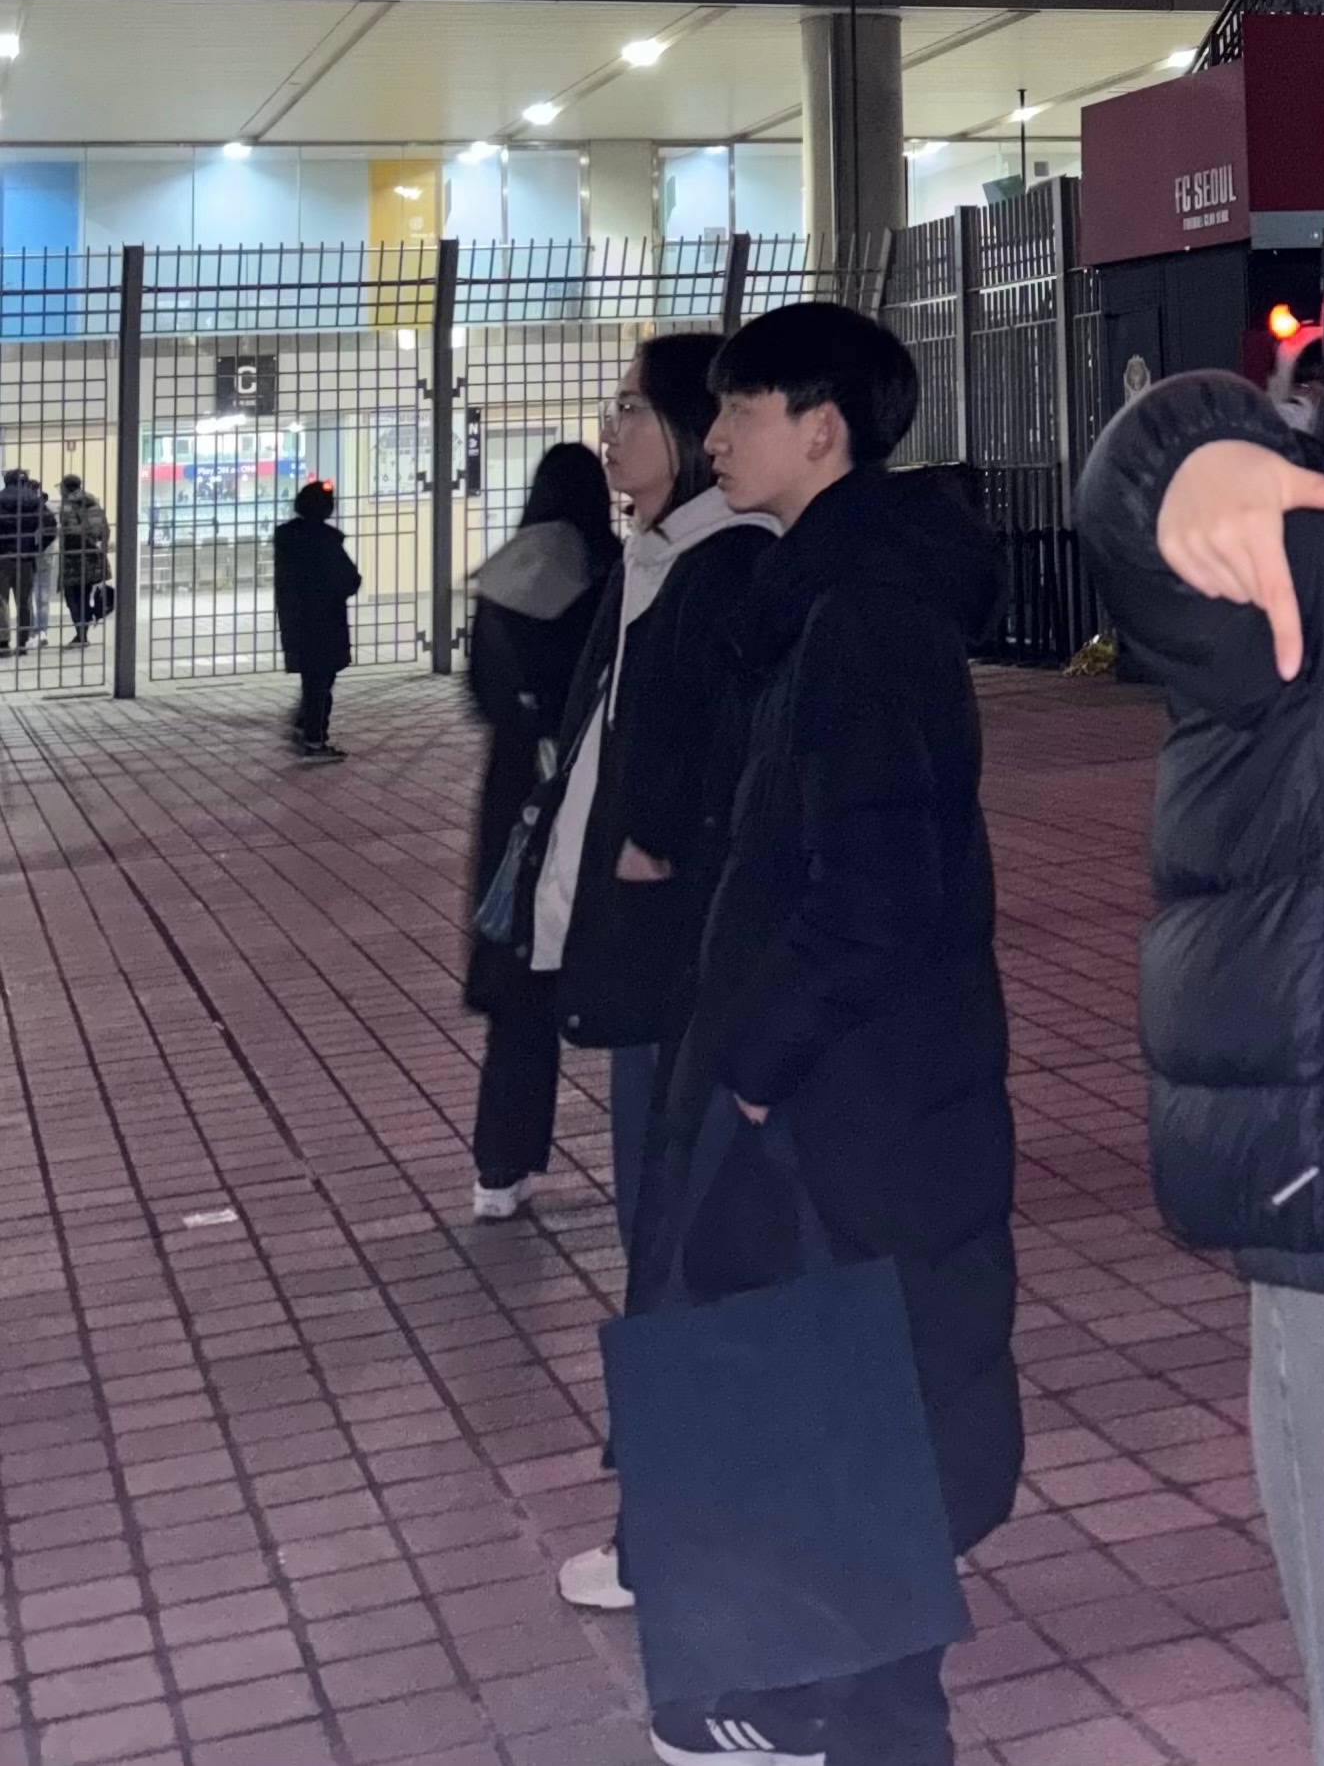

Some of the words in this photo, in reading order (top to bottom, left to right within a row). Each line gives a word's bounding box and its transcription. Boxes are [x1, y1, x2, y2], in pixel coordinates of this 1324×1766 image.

[1174, 174, 1192, 214] FC
[1194, 164, 1237, 210] SEOUL
[236, 365, 258, 394] C
